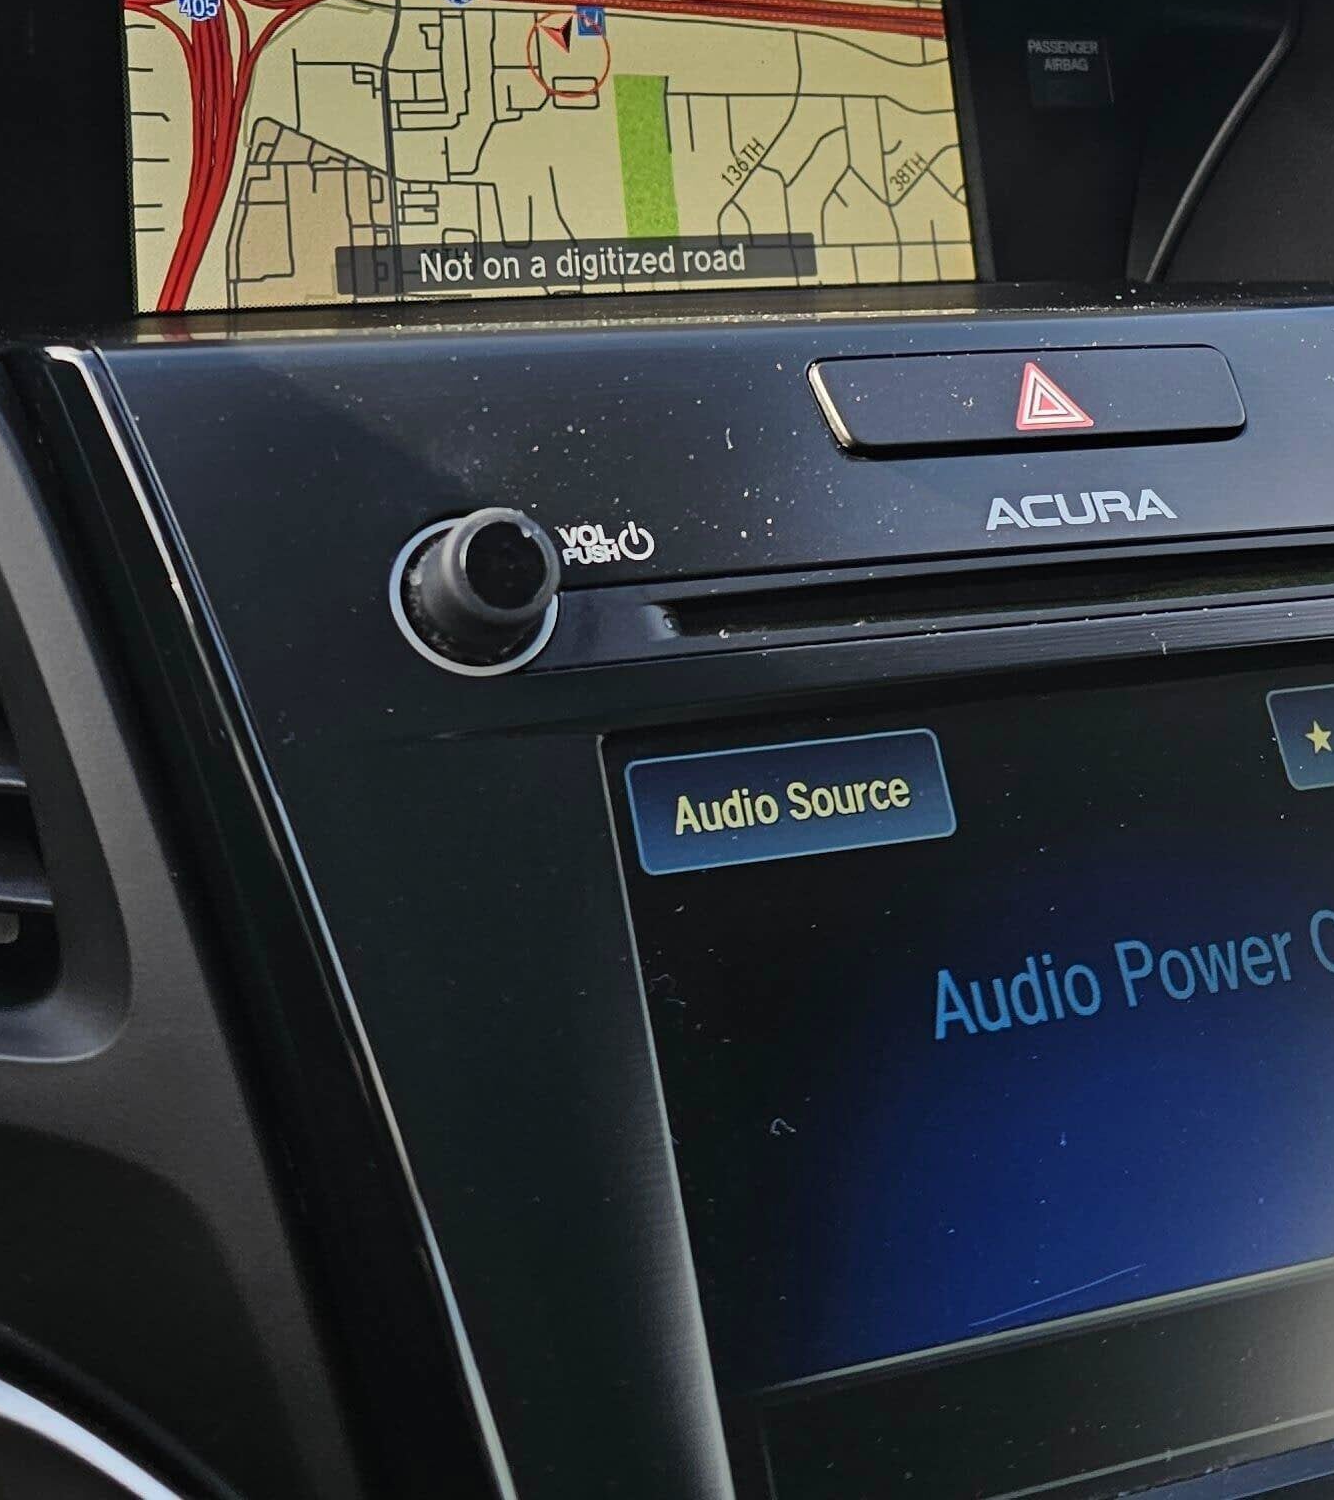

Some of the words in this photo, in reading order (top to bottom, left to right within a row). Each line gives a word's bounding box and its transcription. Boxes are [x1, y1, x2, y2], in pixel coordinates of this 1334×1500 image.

[1027, 38, 1099, 55] PASSENGER
[1044, 57, 1089, 71] AIRBAG
[721, 136, 766, 187] 136TH
[889, 151, 928, 192] 38TH
[420, 251, 475, 283] Not
[483, 257, 521, 280] on
[530, 255, 547, 278] a
[556, 245, 676, 281] digitized
[682, 243, 746, 273] road
[985, 488, 1177, 531] ACURA
[558, 523, 615, 548] VOL
[562, 543, 621, 565] PUSH
[673, 786, 779, 836] Audio
[787, 772, 912, 821] Source
[933, 955, 1101, 1040] Audio
[1114, 929, 1292, 1008] Power
